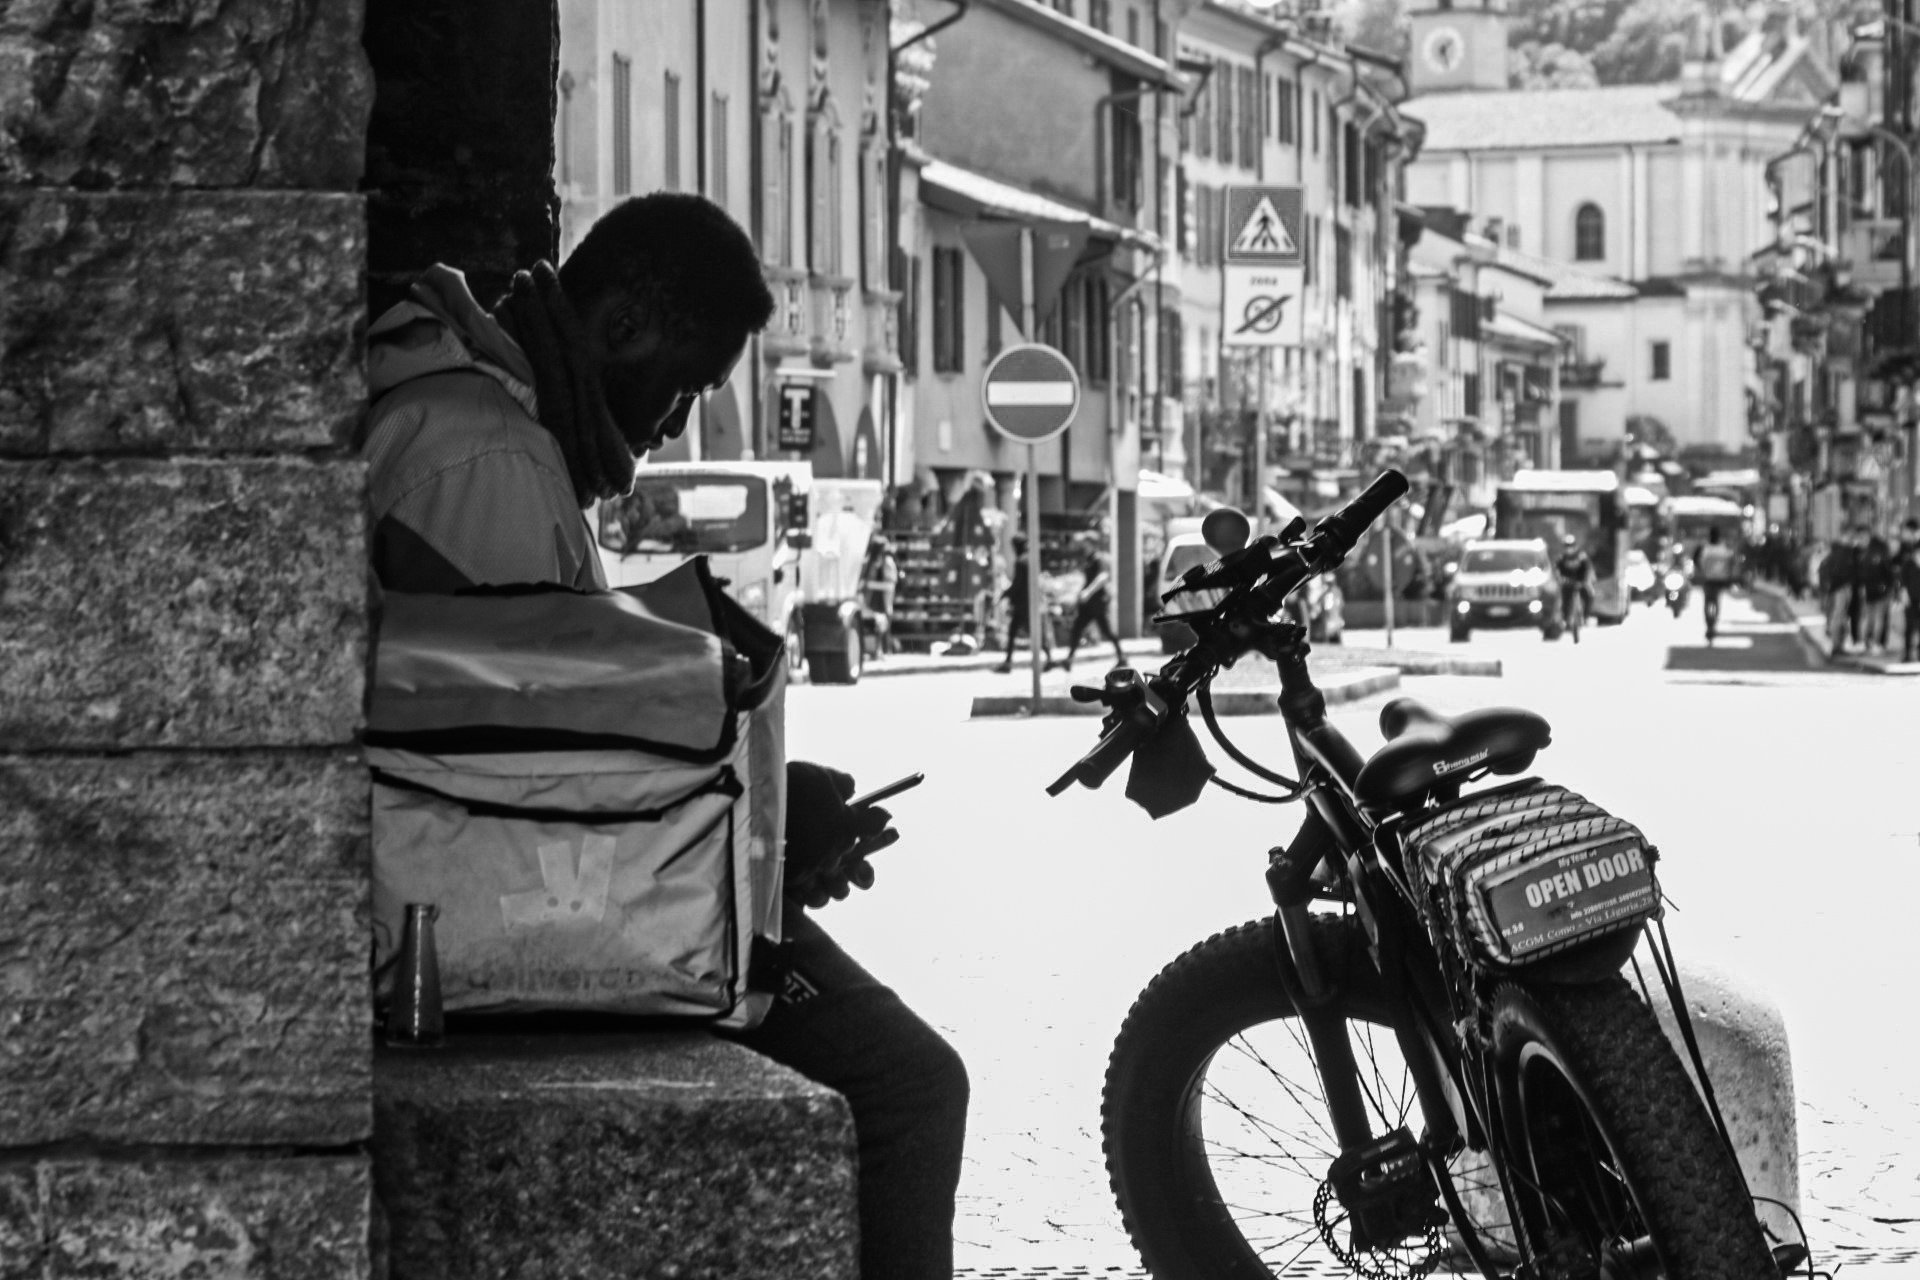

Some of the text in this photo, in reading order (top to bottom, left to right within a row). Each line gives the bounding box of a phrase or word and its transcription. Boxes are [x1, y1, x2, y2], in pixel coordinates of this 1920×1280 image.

[784, 388, 811, 430] T
[1525, 868, 1582, 908] OPEN
[1582, 847, 1645, 889] DOOR
[1547, 924, 1576, 940] Como
[1585, 915, 1602, 926] Via
